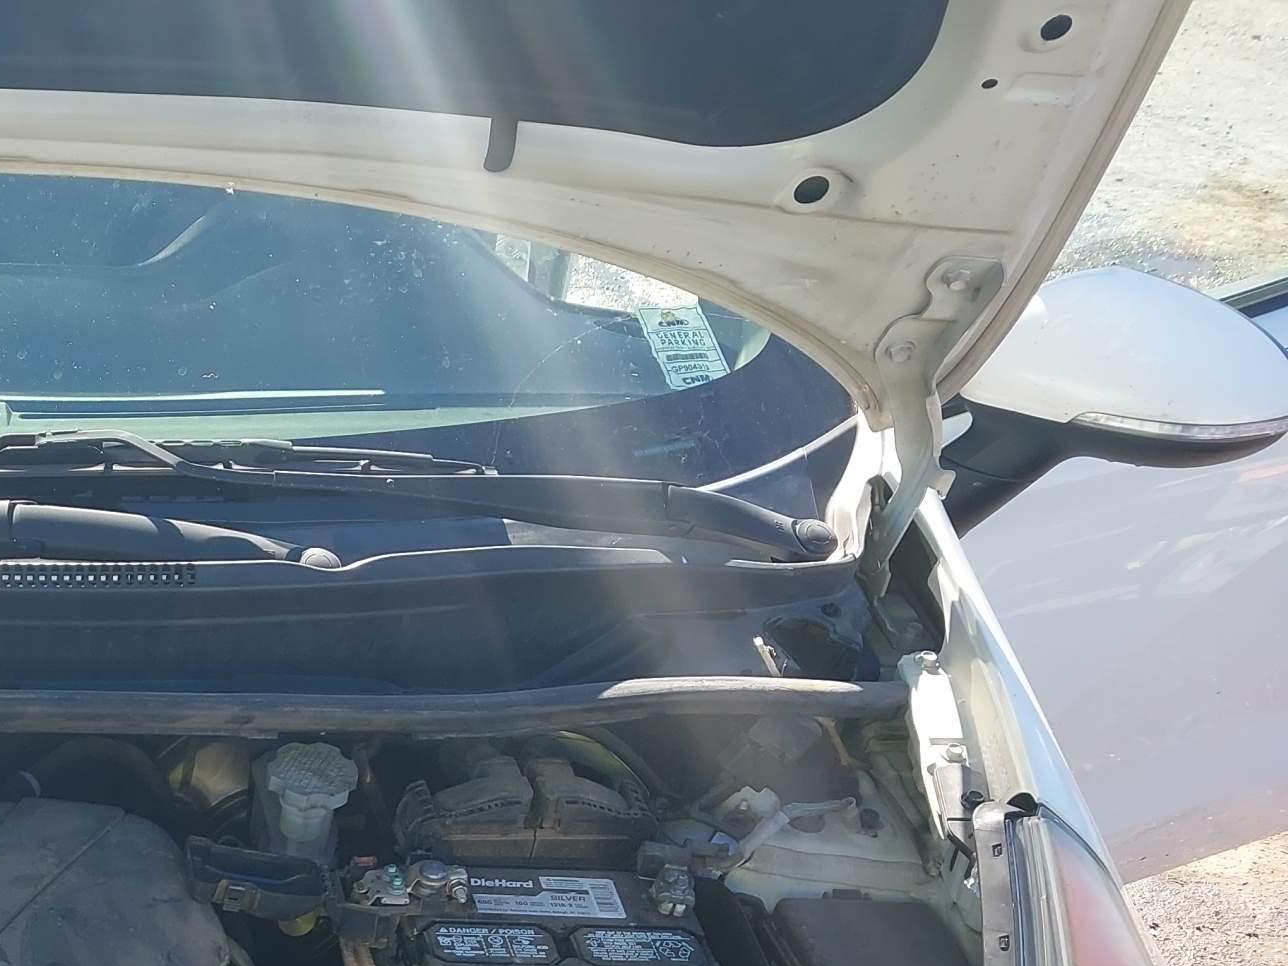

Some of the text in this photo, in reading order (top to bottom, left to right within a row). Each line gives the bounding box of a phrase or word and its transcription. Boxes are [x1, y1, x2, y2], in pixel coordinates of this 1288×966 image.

[655, 331, 705, 339] GENERAL
[681, 374, 711, 385] CNM
[470, 877, 533, 888] DieHard
[550, 894, 586, 903] SILVER
